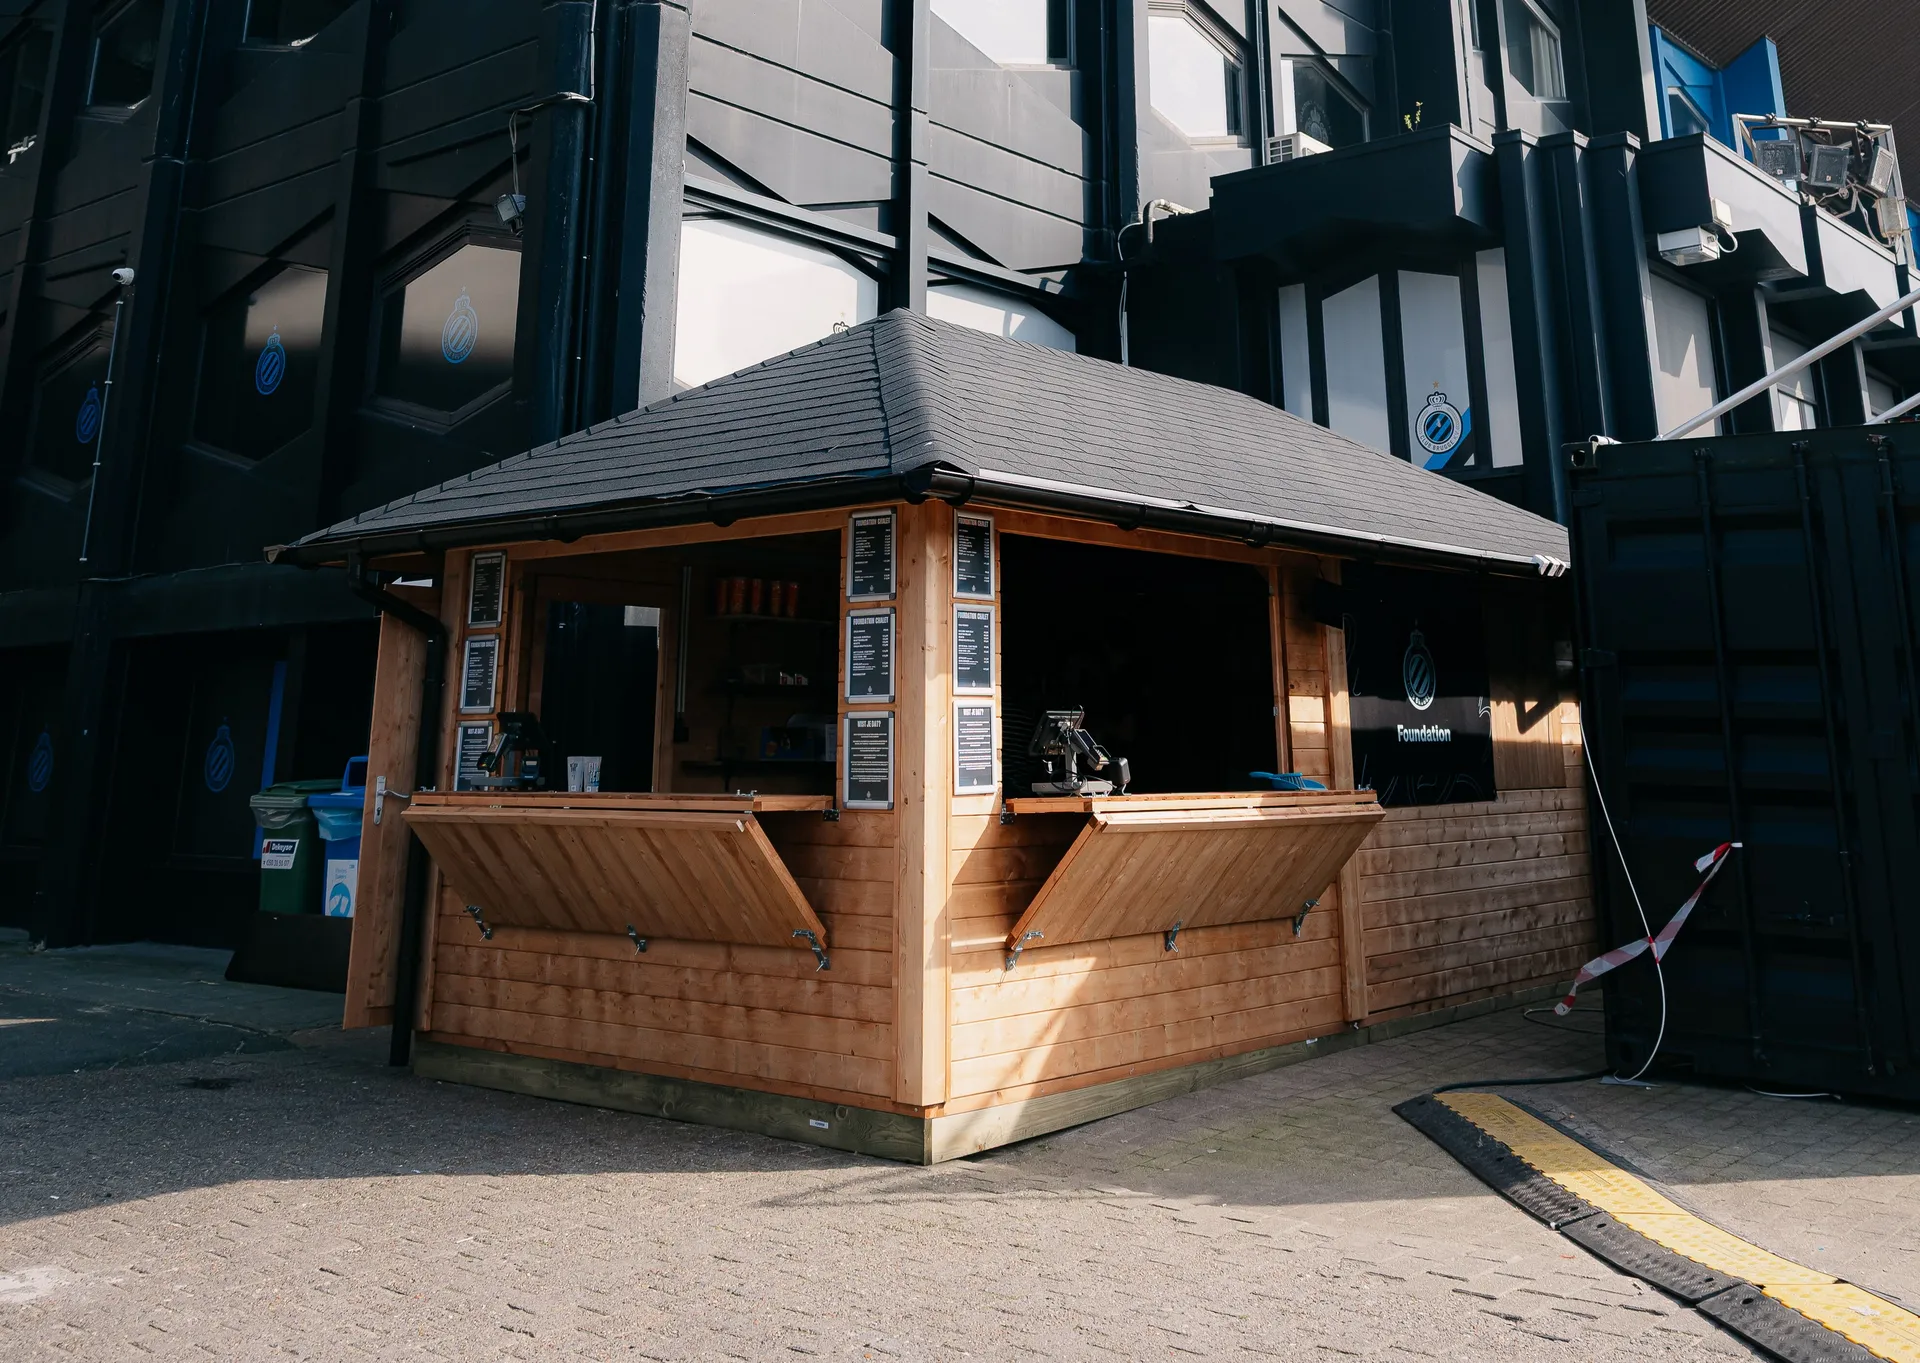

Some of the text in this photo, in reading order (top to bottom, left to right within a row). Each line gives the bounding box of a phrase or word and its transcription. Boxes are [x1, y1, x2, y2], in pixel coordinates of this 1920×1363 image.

[1420, 435, 1432, 448] CLUB
[1432, 440, 1454, 451] BRUGGE
[958, 518, 977, 526] FOUNDATION
[958, 611, 989, 620] FOUNDATION CHALET
[853, 616, 889, 625] FOUNDATION CHALET
[867, 720, 872, 728] JE
[872, 720, 882, 728] DAT?
[1397, 724, 1451, 742] Foundation
